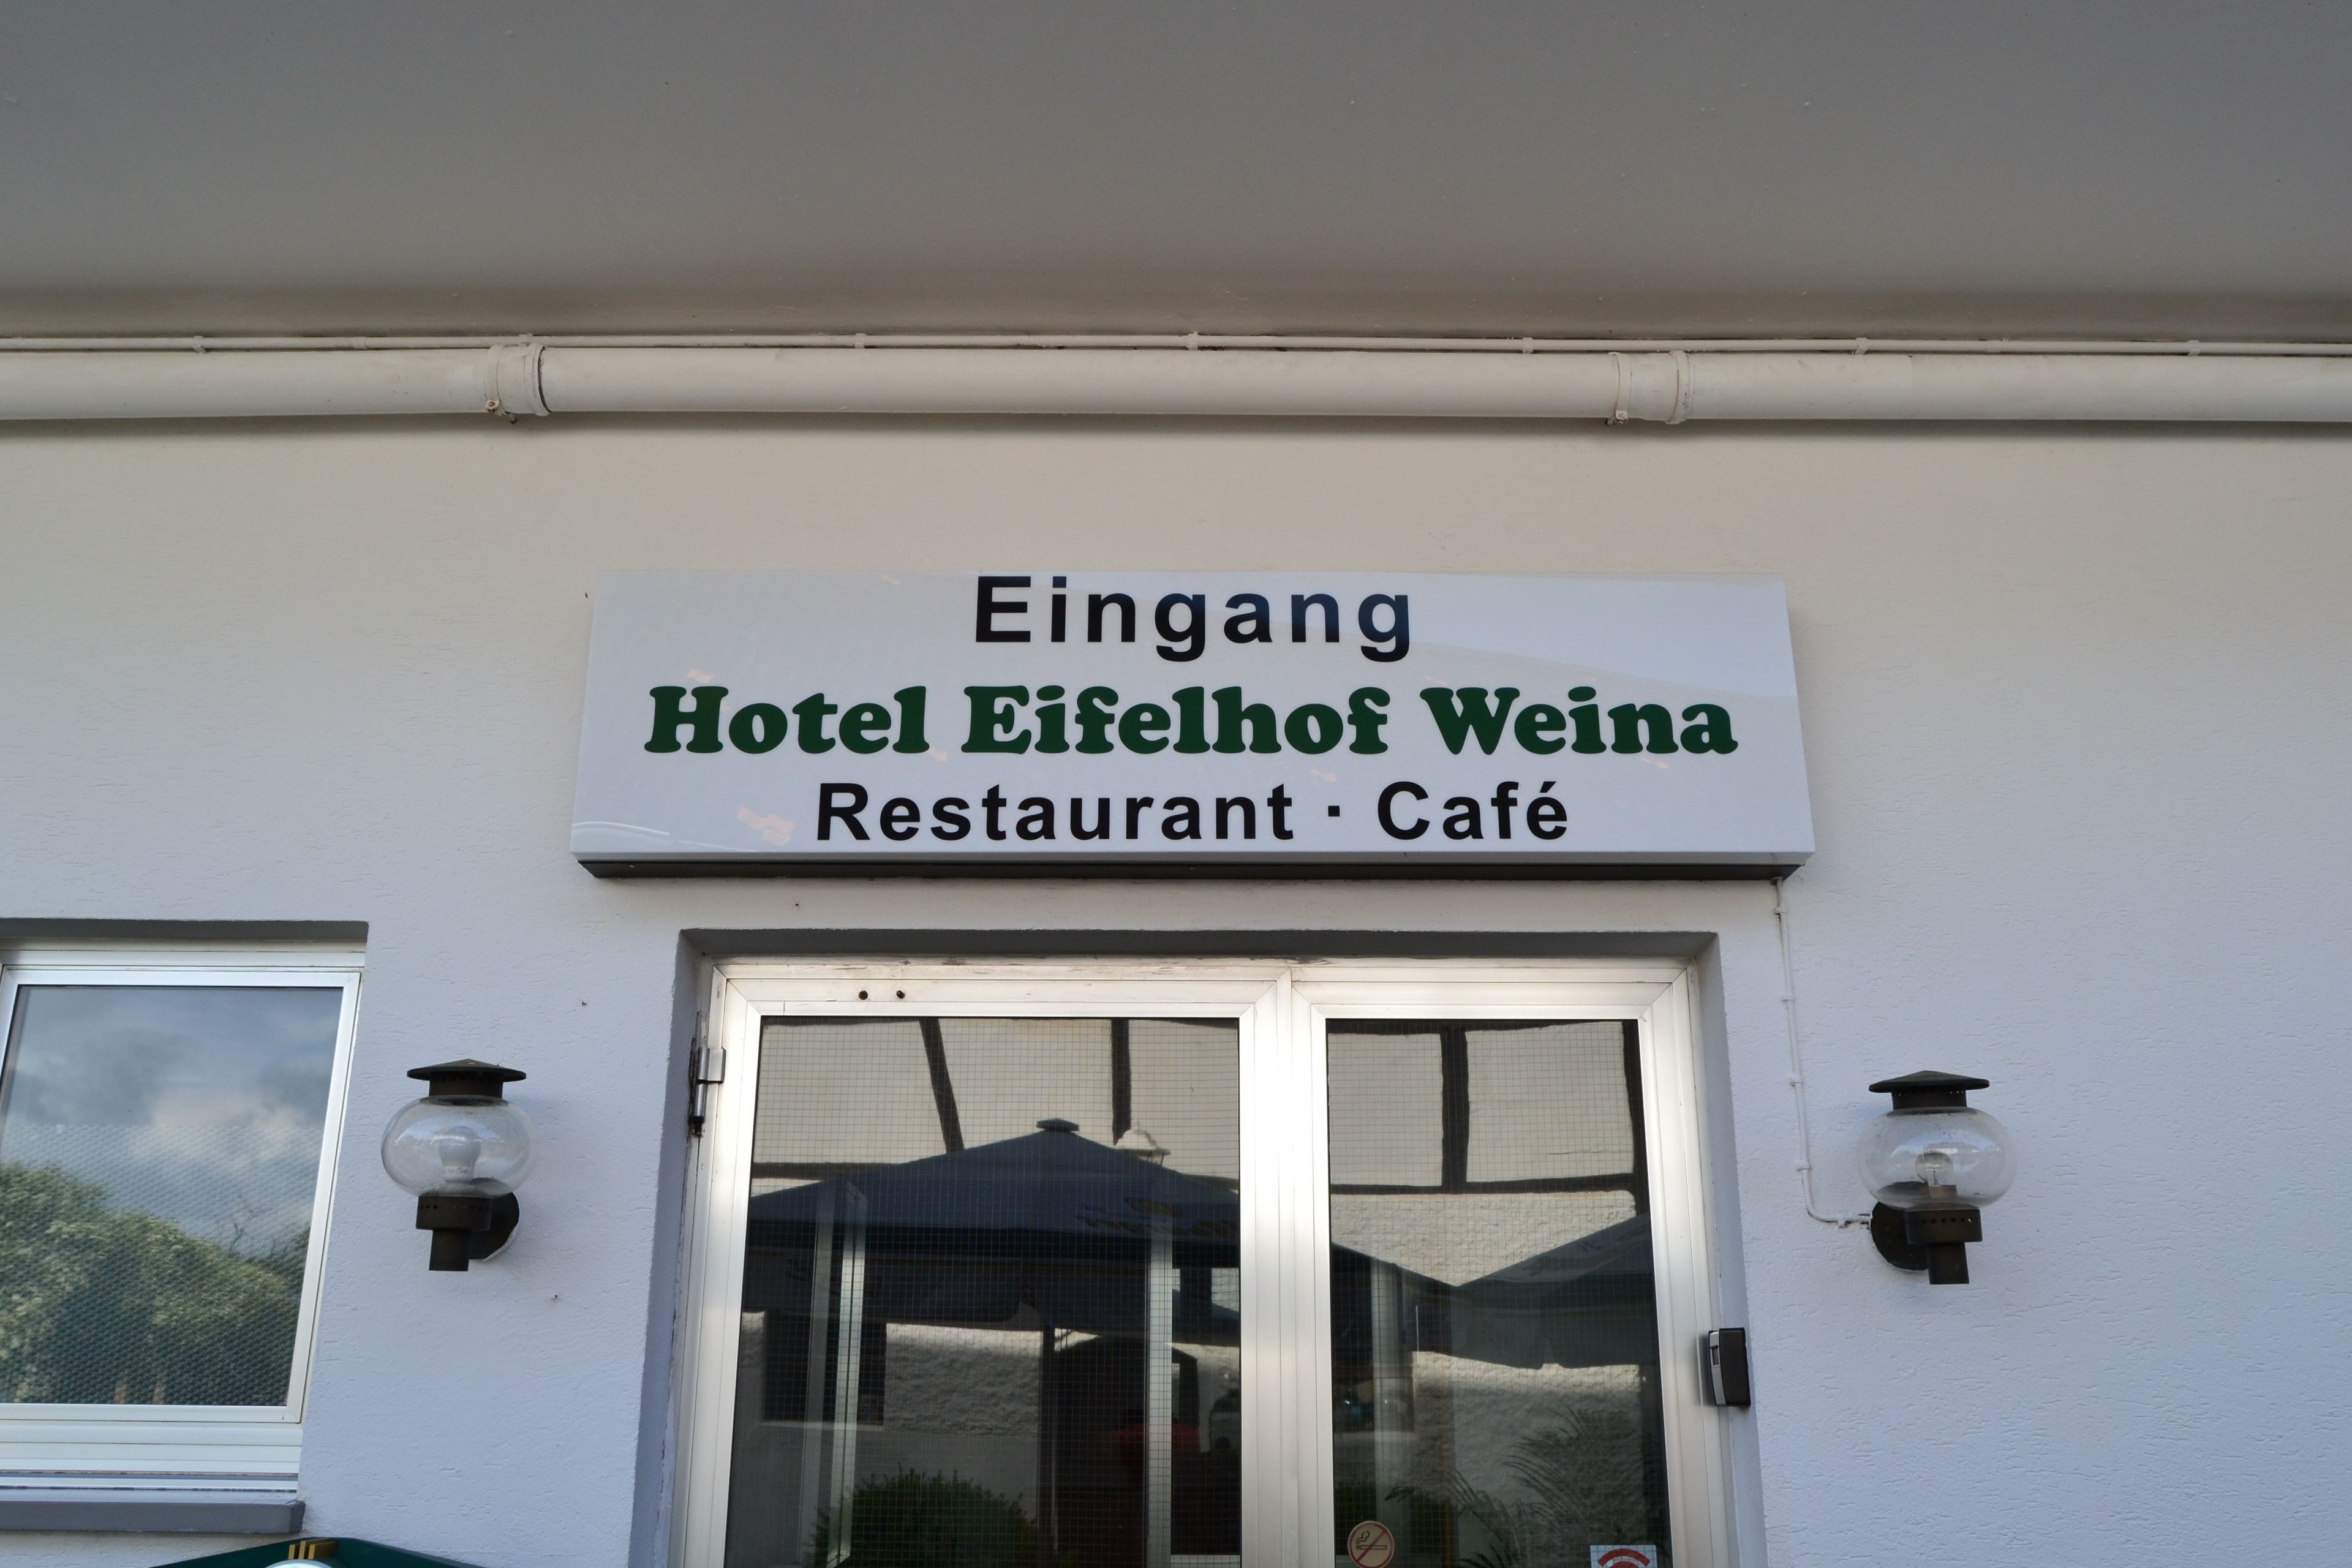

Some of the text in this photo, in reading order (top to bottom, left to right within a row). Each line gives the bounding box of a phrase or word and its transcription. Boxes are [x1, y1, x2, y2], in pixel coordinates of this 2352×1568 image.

[976, 576, 1410, 663] Eingang
[644, 685, 1739, 755] Hotel Eifelhof Weina
[817, 783, 1294, 842] Restaurant
[1378, 781, 1567, 840] Café
